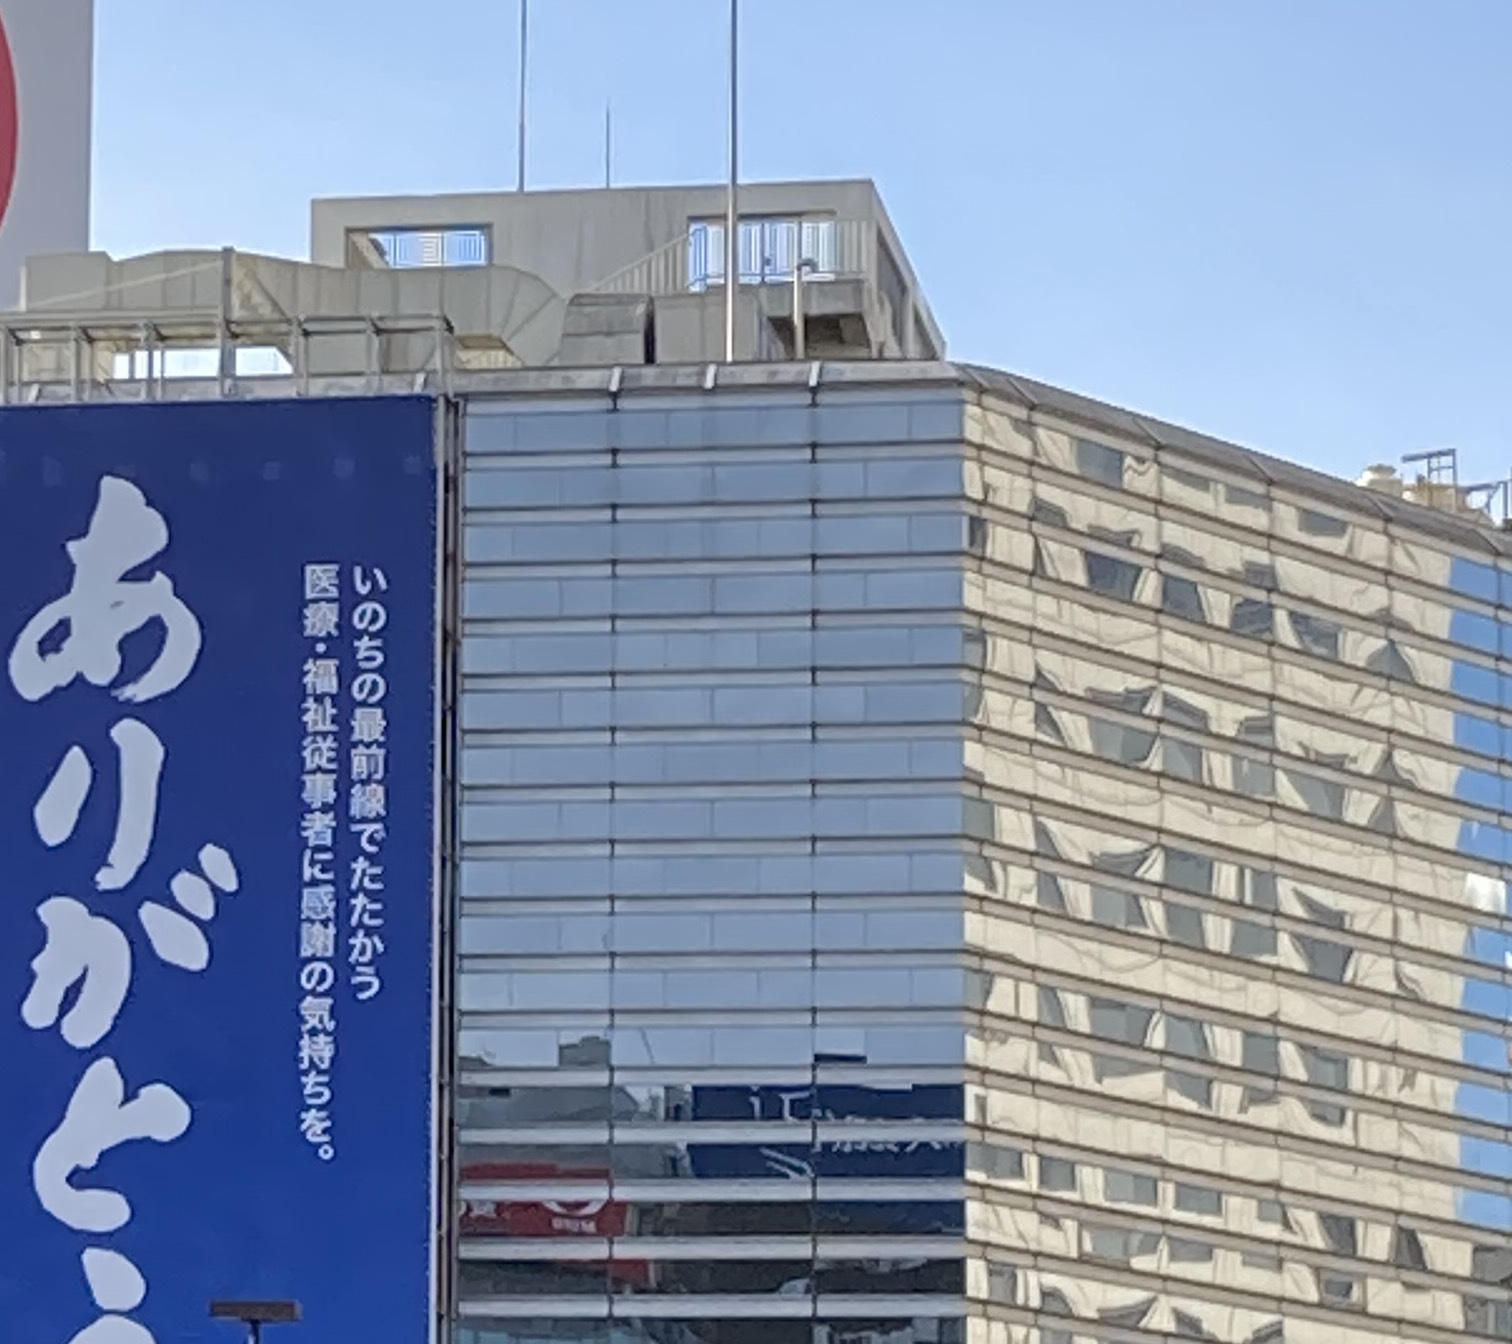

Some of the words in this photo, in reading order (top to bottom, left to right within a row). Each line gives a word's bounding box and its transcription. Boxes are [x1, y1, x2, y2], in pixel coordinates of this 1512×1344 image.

[297, 563, 341, 1161] 医療・福祉従事者に感謝の気持ちを。
[347, 565, 389, 1001] いのちの最前線でたたかう
